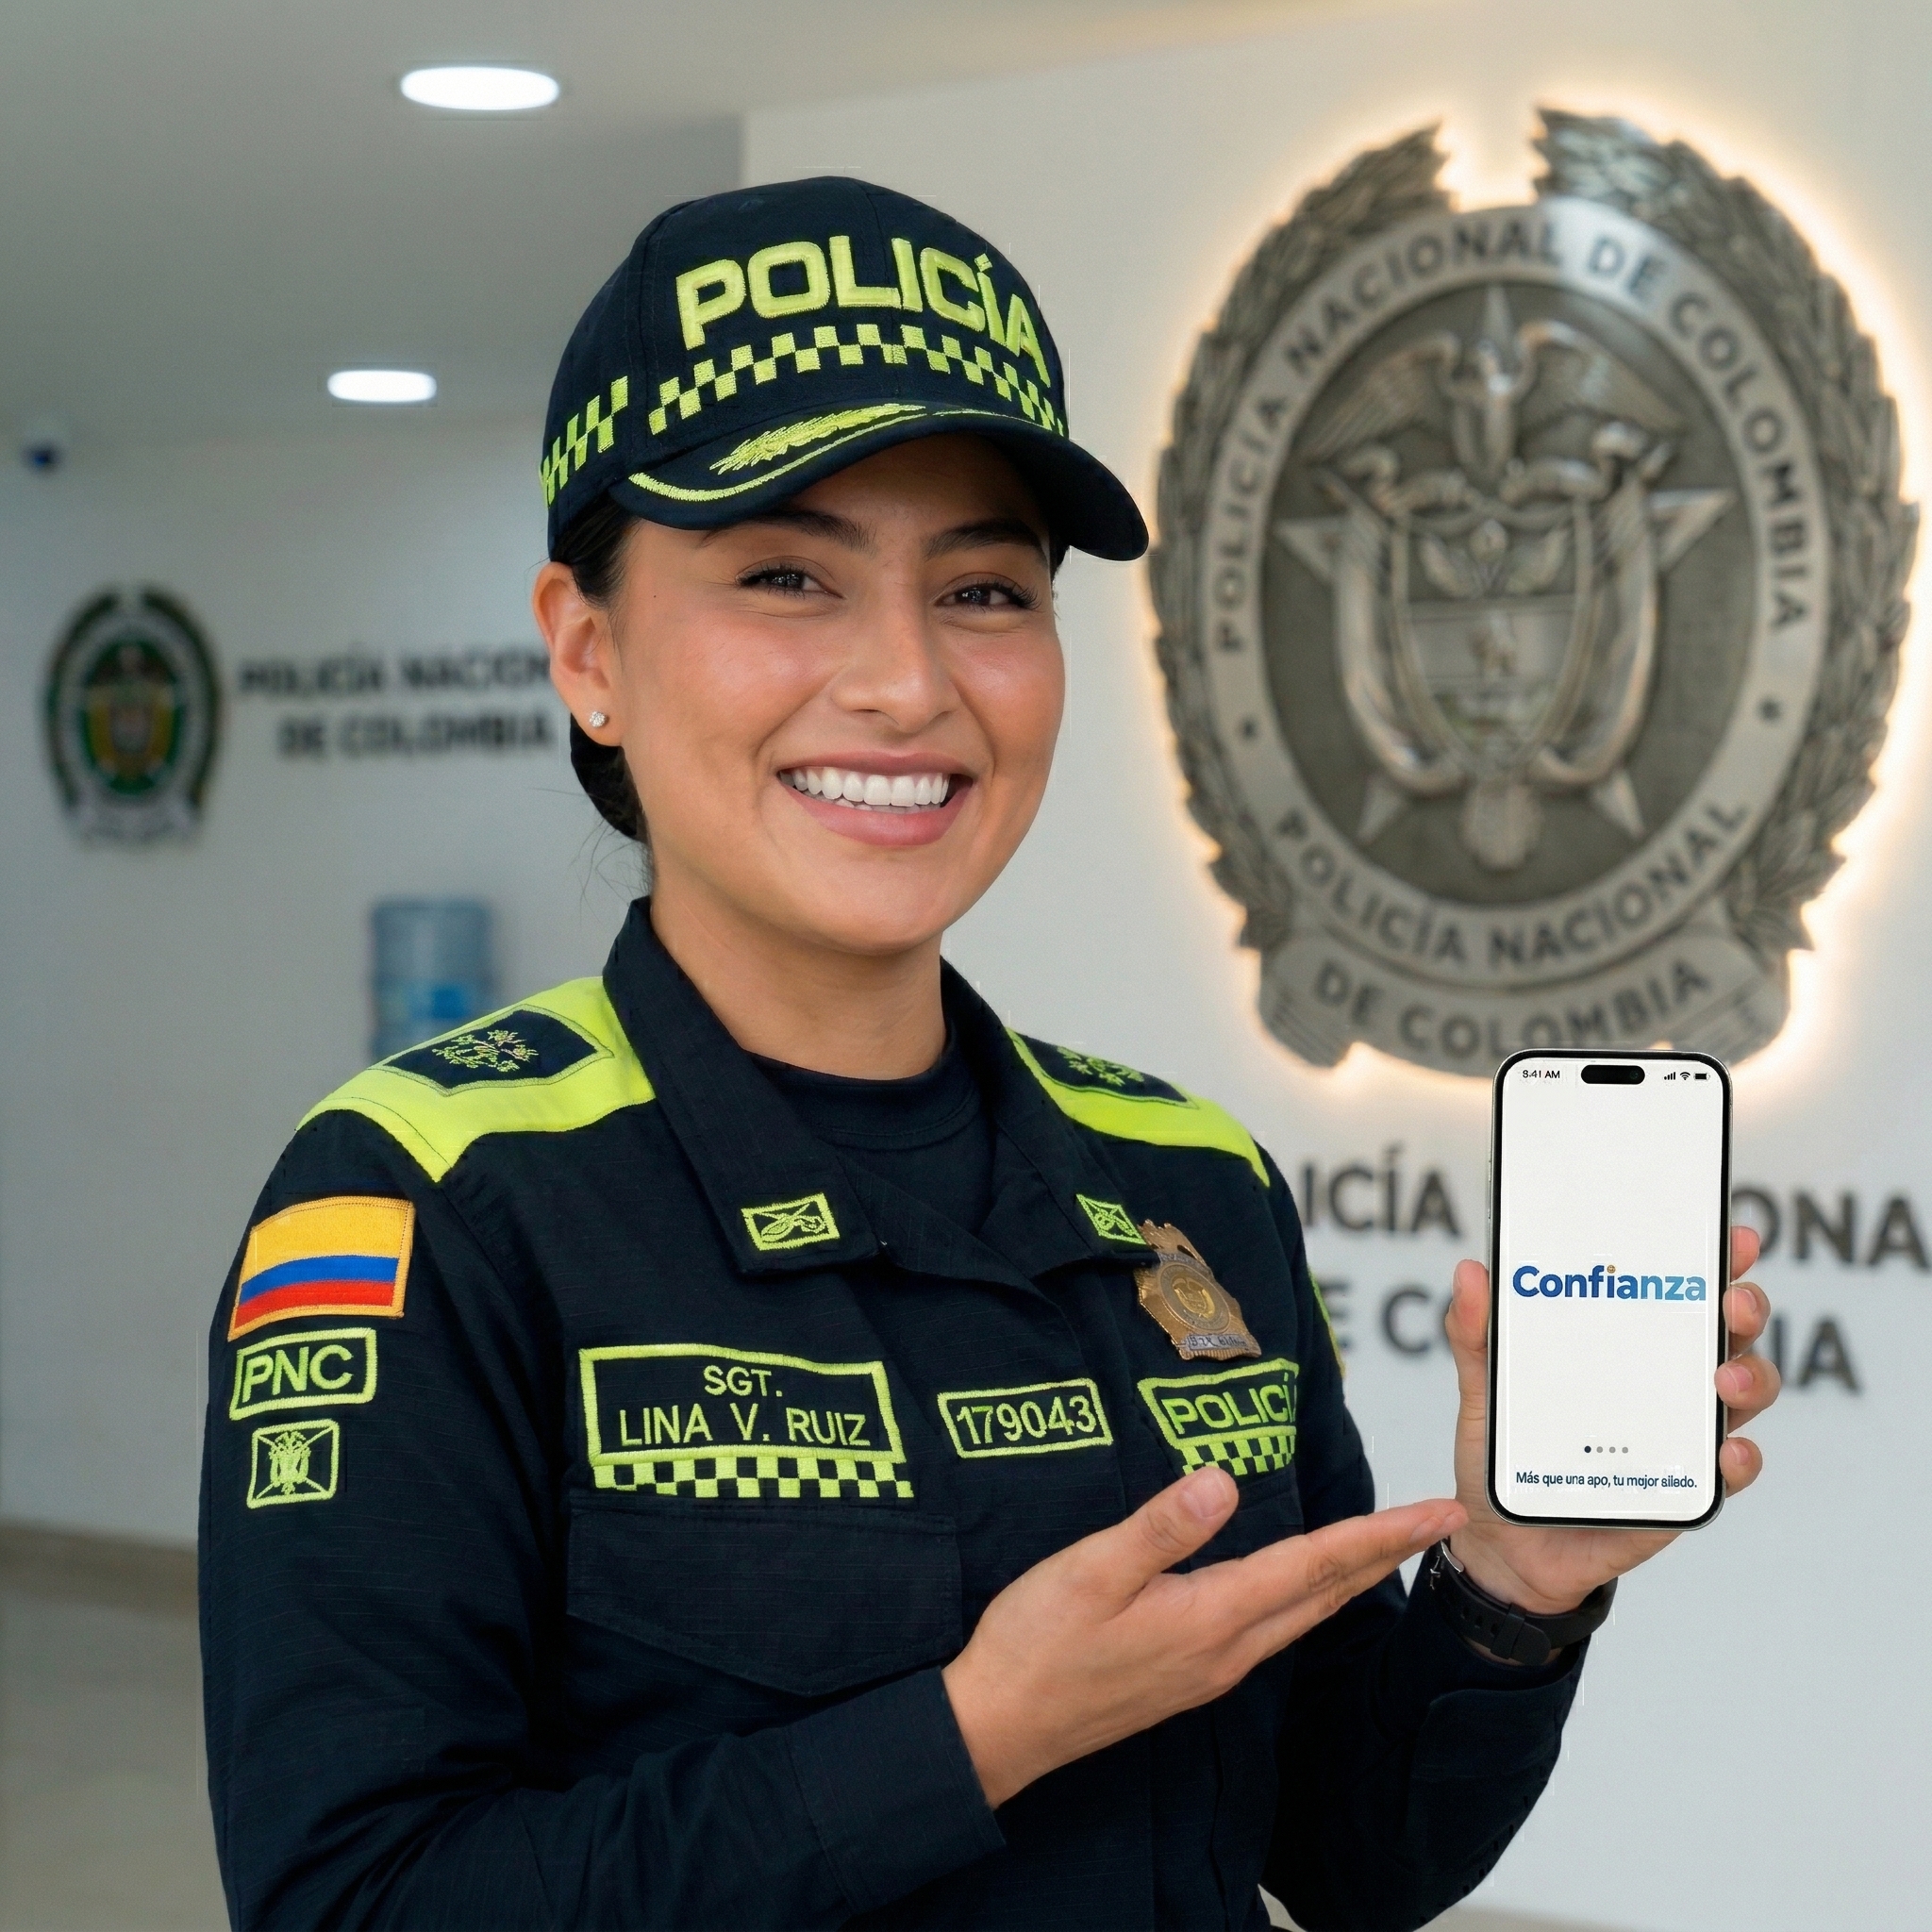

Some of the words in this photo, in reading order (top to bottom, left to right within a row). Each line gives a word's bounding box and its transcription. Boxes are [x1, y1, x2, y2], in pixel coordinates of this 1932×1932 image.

[676, 235, 1051, 388] POLICÍA
[1284, 219, 1562, 375] NACIONAL
[1587, 235, 1668, 305] DE
[1668, 291, 1810, 629] COLOMBIA
[1488, 801, 1748, 969] NACIONAL
[1312, 958, 1383, 1027] DE
[1396, 958, 1712, 1060] COLOMBIA
[1544, 1070, 1560, 1078] AM
[1302, 1140, 1465, 1241] ICÍA
[1512, 1264, 1707, 1301] Confianza
[242, 1344, 355, 1404] PNC
[704, 1365, 782, 1397] SGT.
[1161, 1372, 1297, 1435] POLICÍ
[620, 1407, 713, 1447] LINA
[734, 1403, 771, 1442] V.
[787, 1409, 871, 1446] RUIZ
[956, 1394, 1097, 1445] 179043
[1516, 1471, 1540, 1484] Más
[1542, 1474, 1563, 1488] que
[1565, 1475, 1585, 1485] una
[1613, 1474, 1624, 1486] tu
